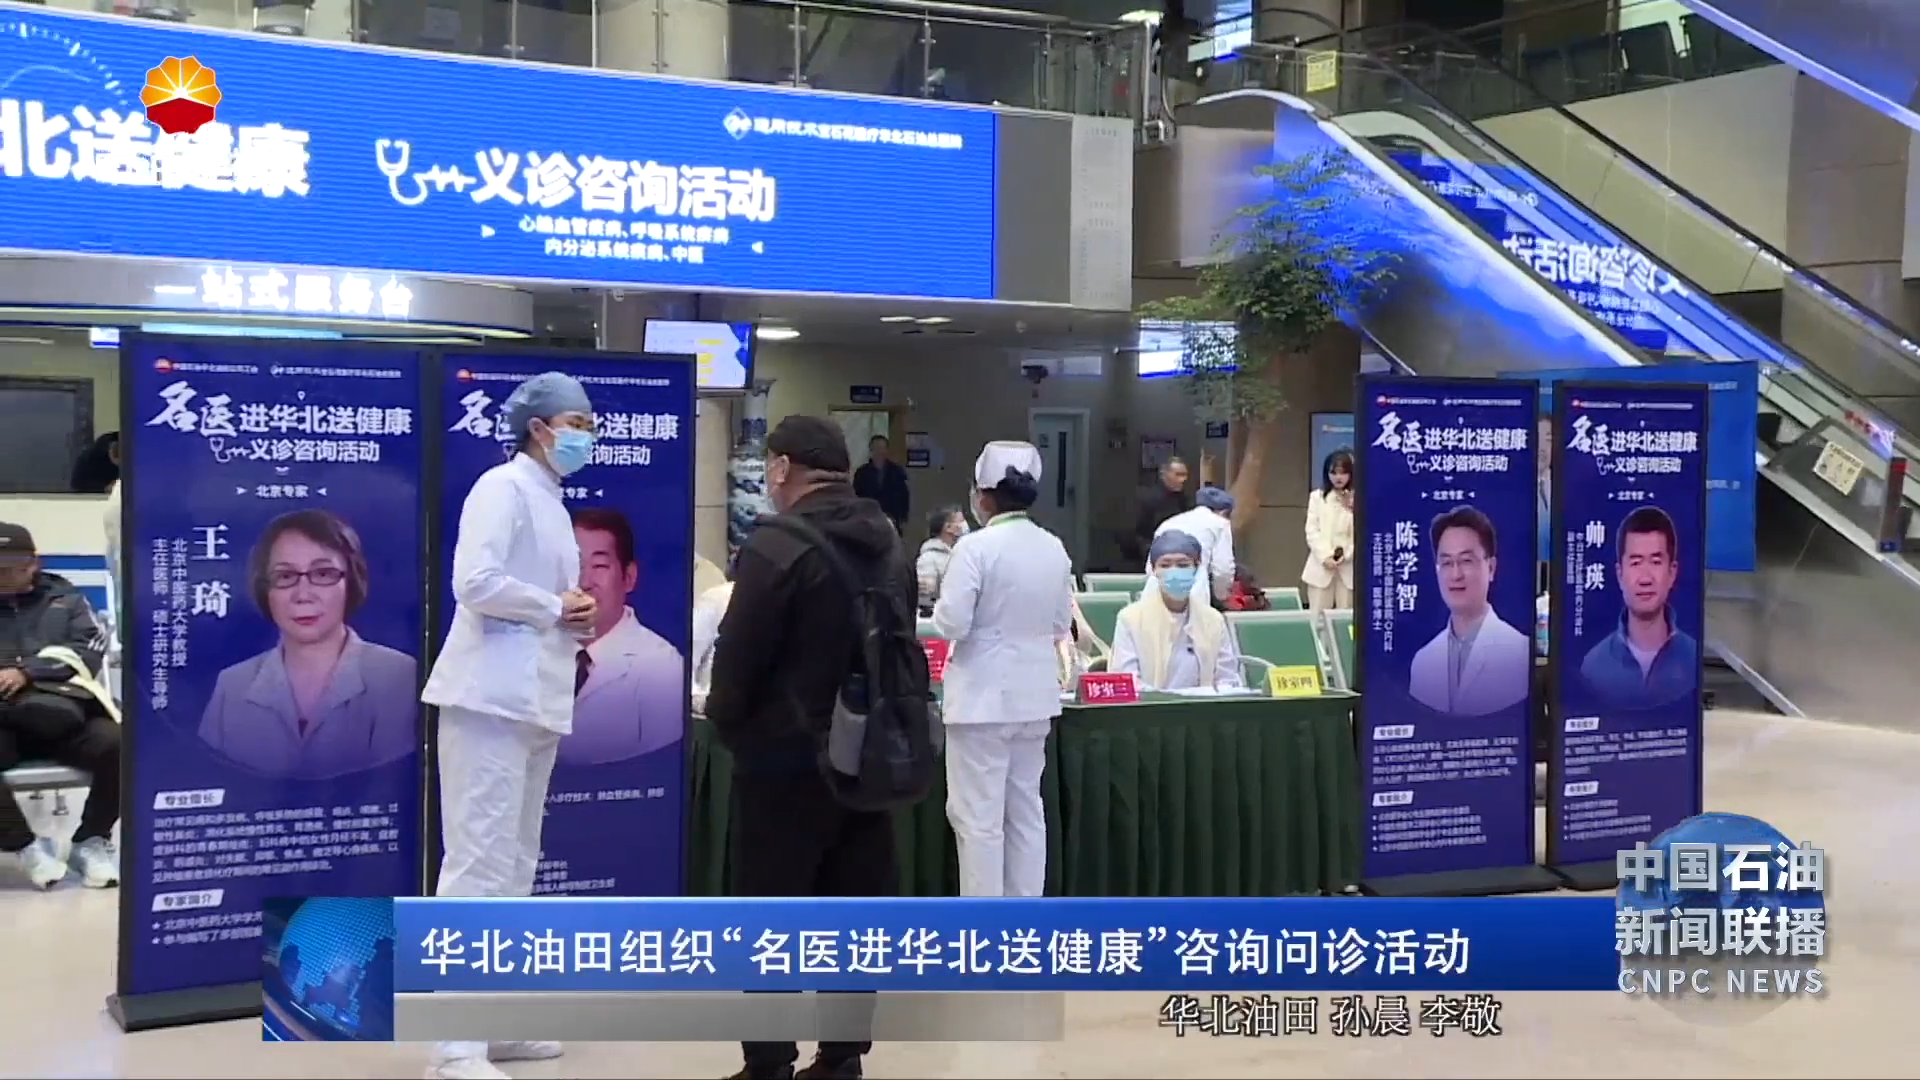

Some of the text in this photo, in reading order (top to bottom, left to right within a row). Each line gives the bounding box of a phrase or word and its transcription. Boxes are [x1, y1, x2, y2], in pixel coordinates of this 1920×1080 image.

[471, 147, 777, 222] 义诊咨询活动
[153, 265, 413, 319] 一站式服务台
[145, 380, 413, 438] 名医进华北送健康
[249, 438, 380, 464] 义诊咨询活动
[1371, 411, 1529, 456] 名医进华北送健康
[1566, 415, 1698, 456] 名医进华北送健康
[1429, 454, 1509, 473] 义诊咨询活动
[1614, 456, 1682, 474] 义诊咨询活动
[255, 485, 309, 498] 北京专家
[191, 524, 232, 619] 王琦
[1395, 520, 1419, 612] 陈学智
[172, 538, 188, 668] 北京中医药大学教授
[1087, 682, 1130, 699] 诊室三
[1275, 675, 1314, 688] 诊室四
